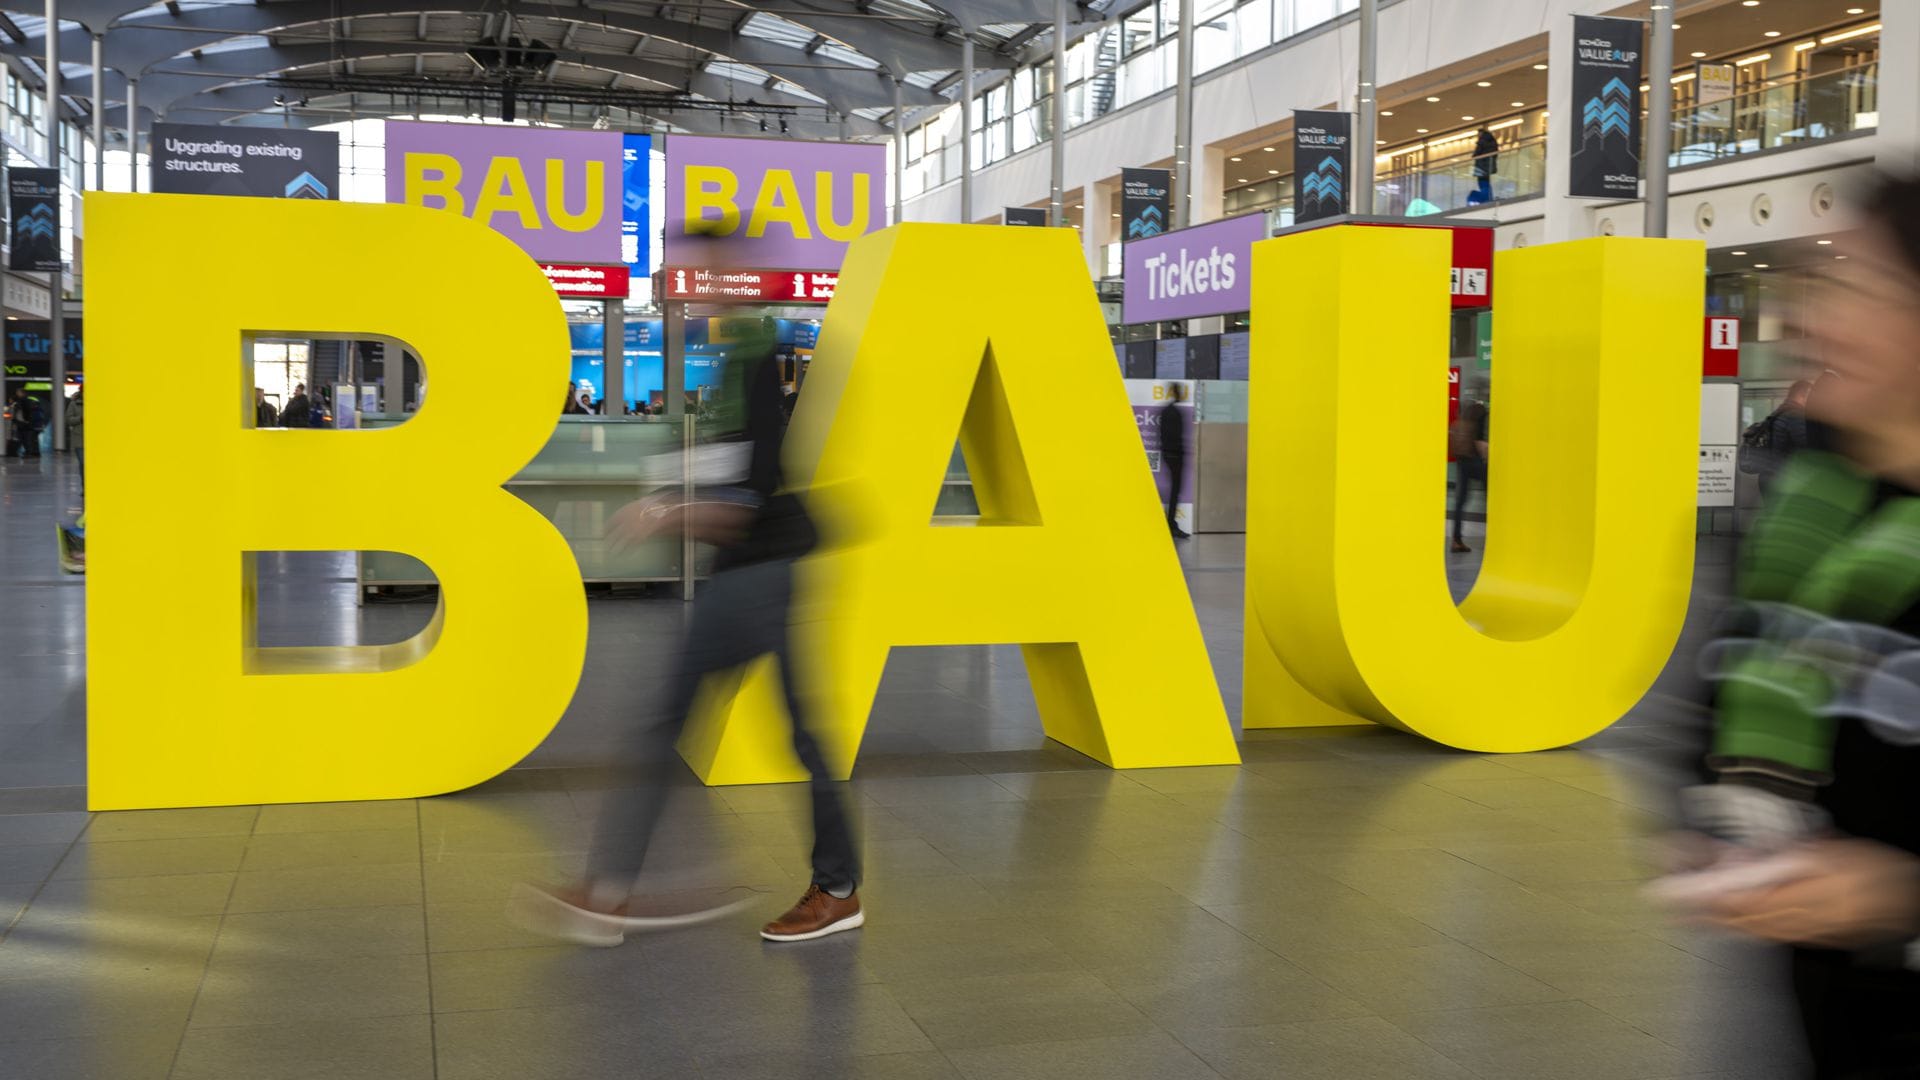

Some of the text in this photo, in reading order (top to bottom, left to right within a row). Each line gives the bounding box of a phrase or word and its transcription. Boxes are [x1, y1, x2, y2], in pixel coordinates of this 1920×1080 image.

[1703, 67, 1731, 81] BAU
[165, 138, 302, 160] Upgrading existing
[165, 158, 244, 173] structures.
[404, 152, 604, 232] BAU
[684, 164, 870, 242] BAU
[695, 270, 760, 284] Information
[1145, 246, 1235, 300] Tickets
[695, 283, 761, 296] Information
[85, 191, 1704, 811] BAU
